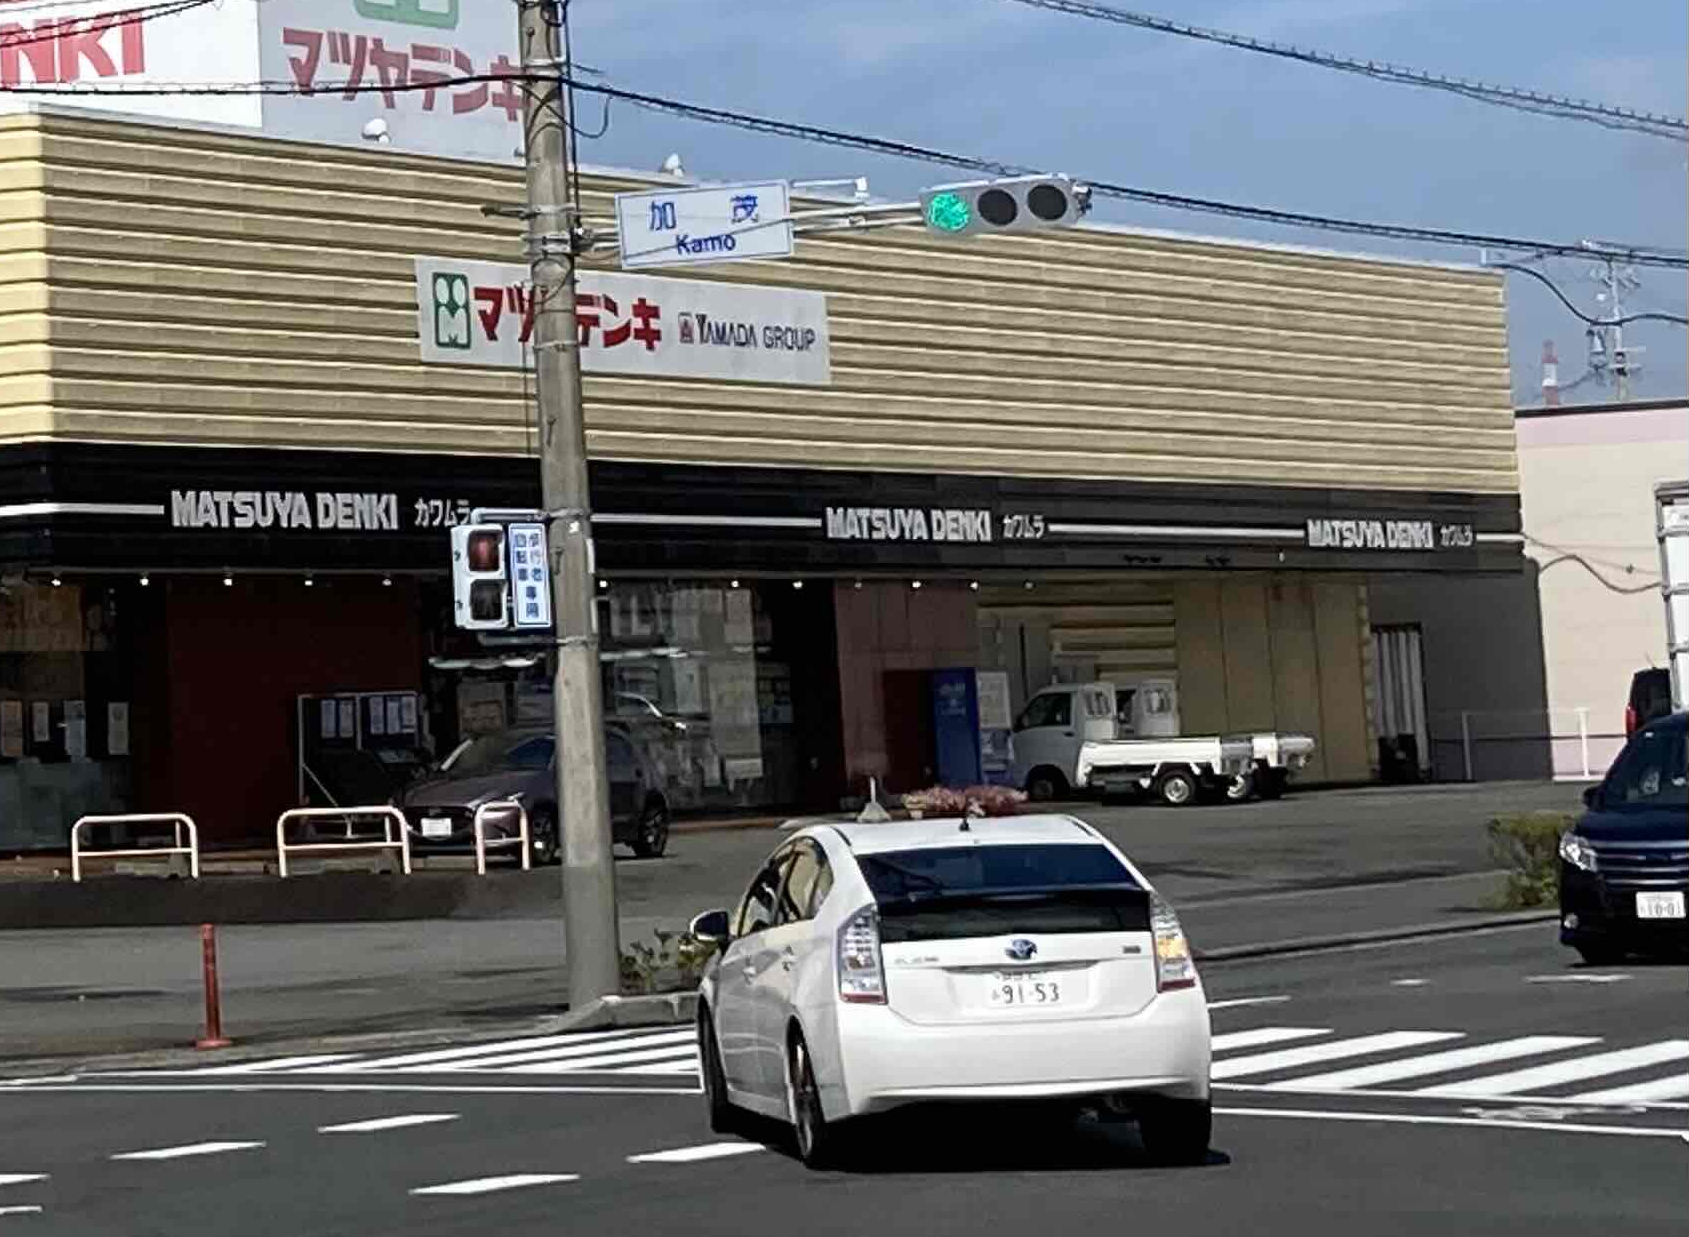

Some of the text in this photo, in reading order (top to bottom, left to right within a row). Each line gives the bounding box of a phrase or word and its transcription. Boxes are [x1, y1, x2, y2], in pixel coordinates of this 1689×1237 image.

[282, 27, 528, 123] マツヤデンキ
[675, 234, 737, 256] Kamo
[473, 285, 663, 352] マツデンキ
[695, 313, 816, 352] YAMADA GROUP
[171, 490, 399, 531] MATSUYA DENKI
[414, 496, 471, 529] カワムラ
[826, 507, 992, 542] MATSUYA DENKI
[1307, 518, 1434, 549] MATSUYA DENKI
